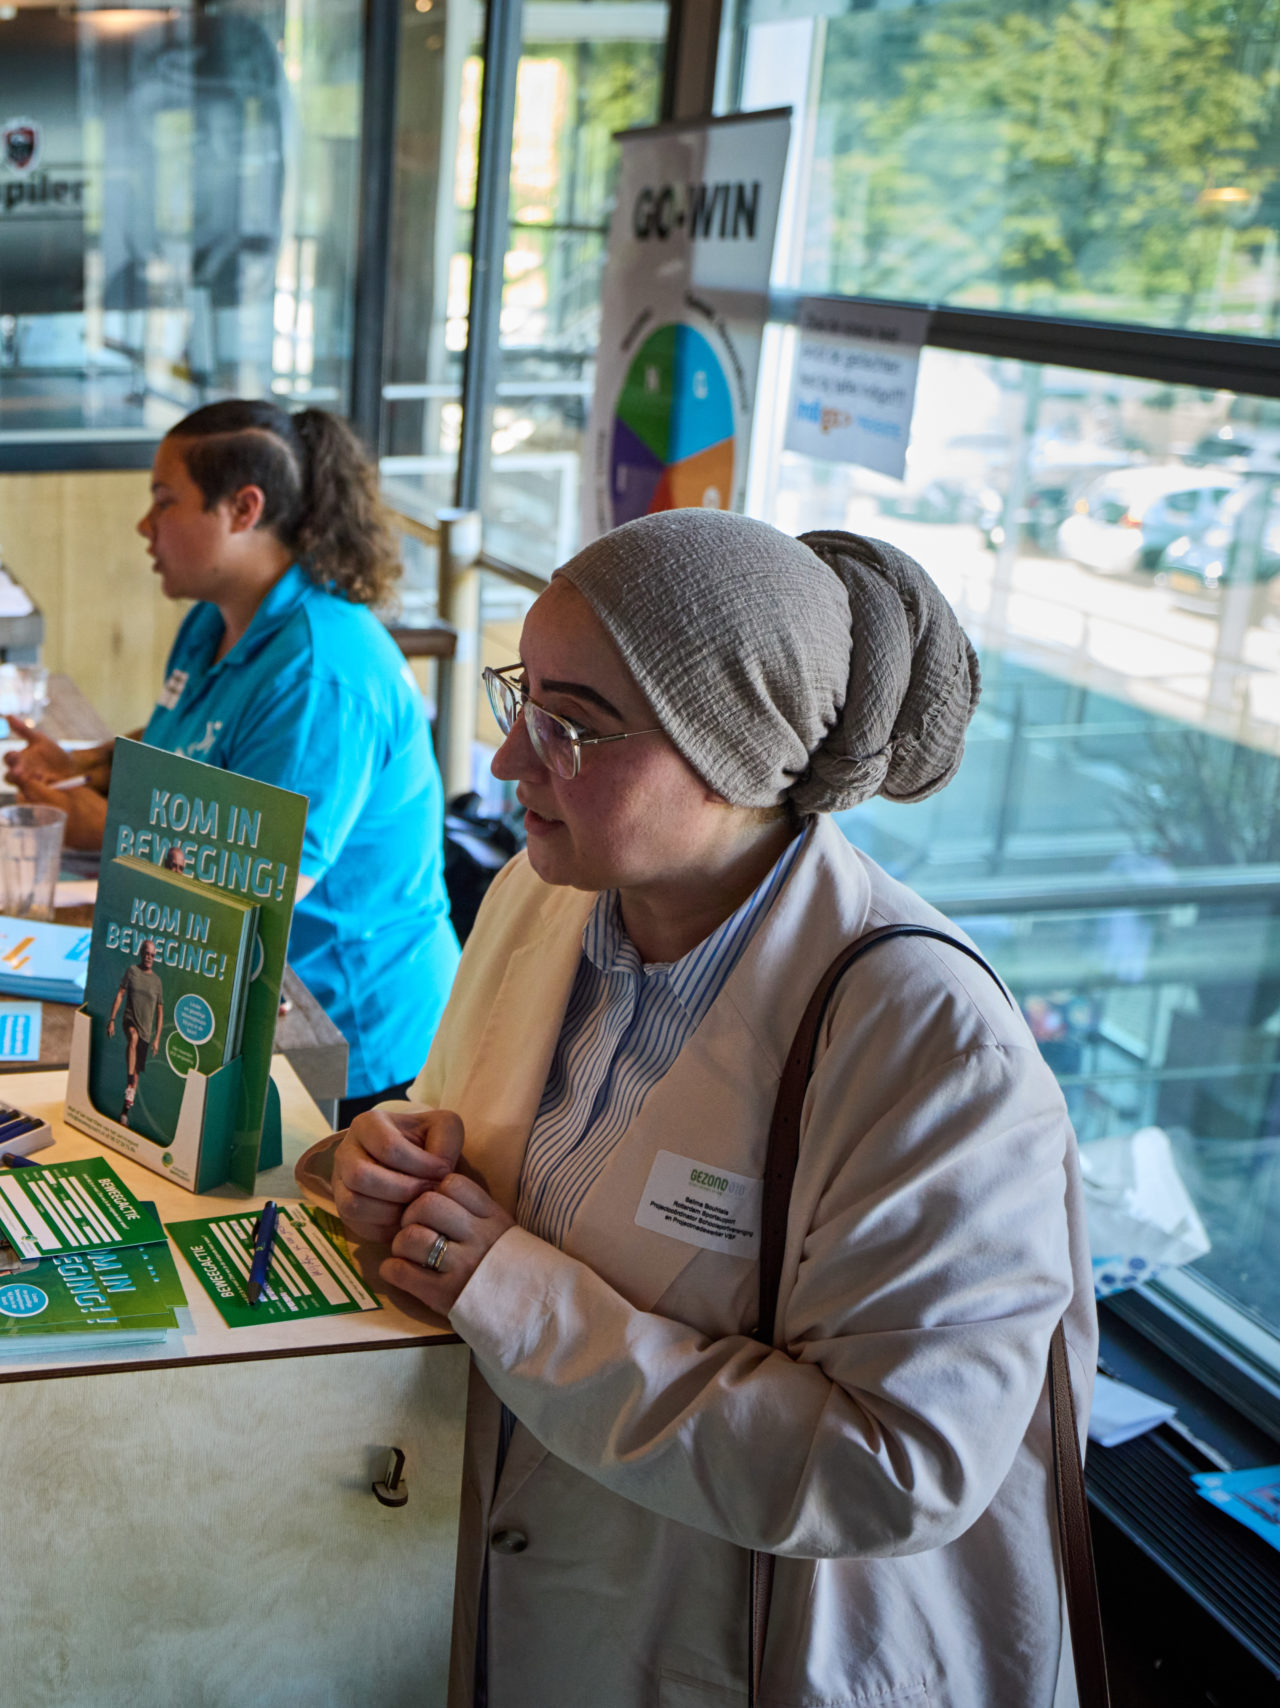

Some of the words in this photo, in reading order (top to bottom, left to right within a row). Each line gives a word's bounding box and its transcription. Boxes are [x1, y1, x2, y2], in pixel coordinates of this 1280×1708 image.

[149, 787, 219, 840] KOM
[226, 805, 262, 849] IN
[130, 897, 181, 937] KOM
[185, 911, 211, 943] IN
[105, 921, 228, 981] BEWEGING!
[97, 1177, 141, 1221] BEWEEGACTIE
[52, 1255, 112, 1313] EGING!
[99, 1273, 137, 1293] IN
[190, 1245, 235, 1299] BEWEEGACTIE
